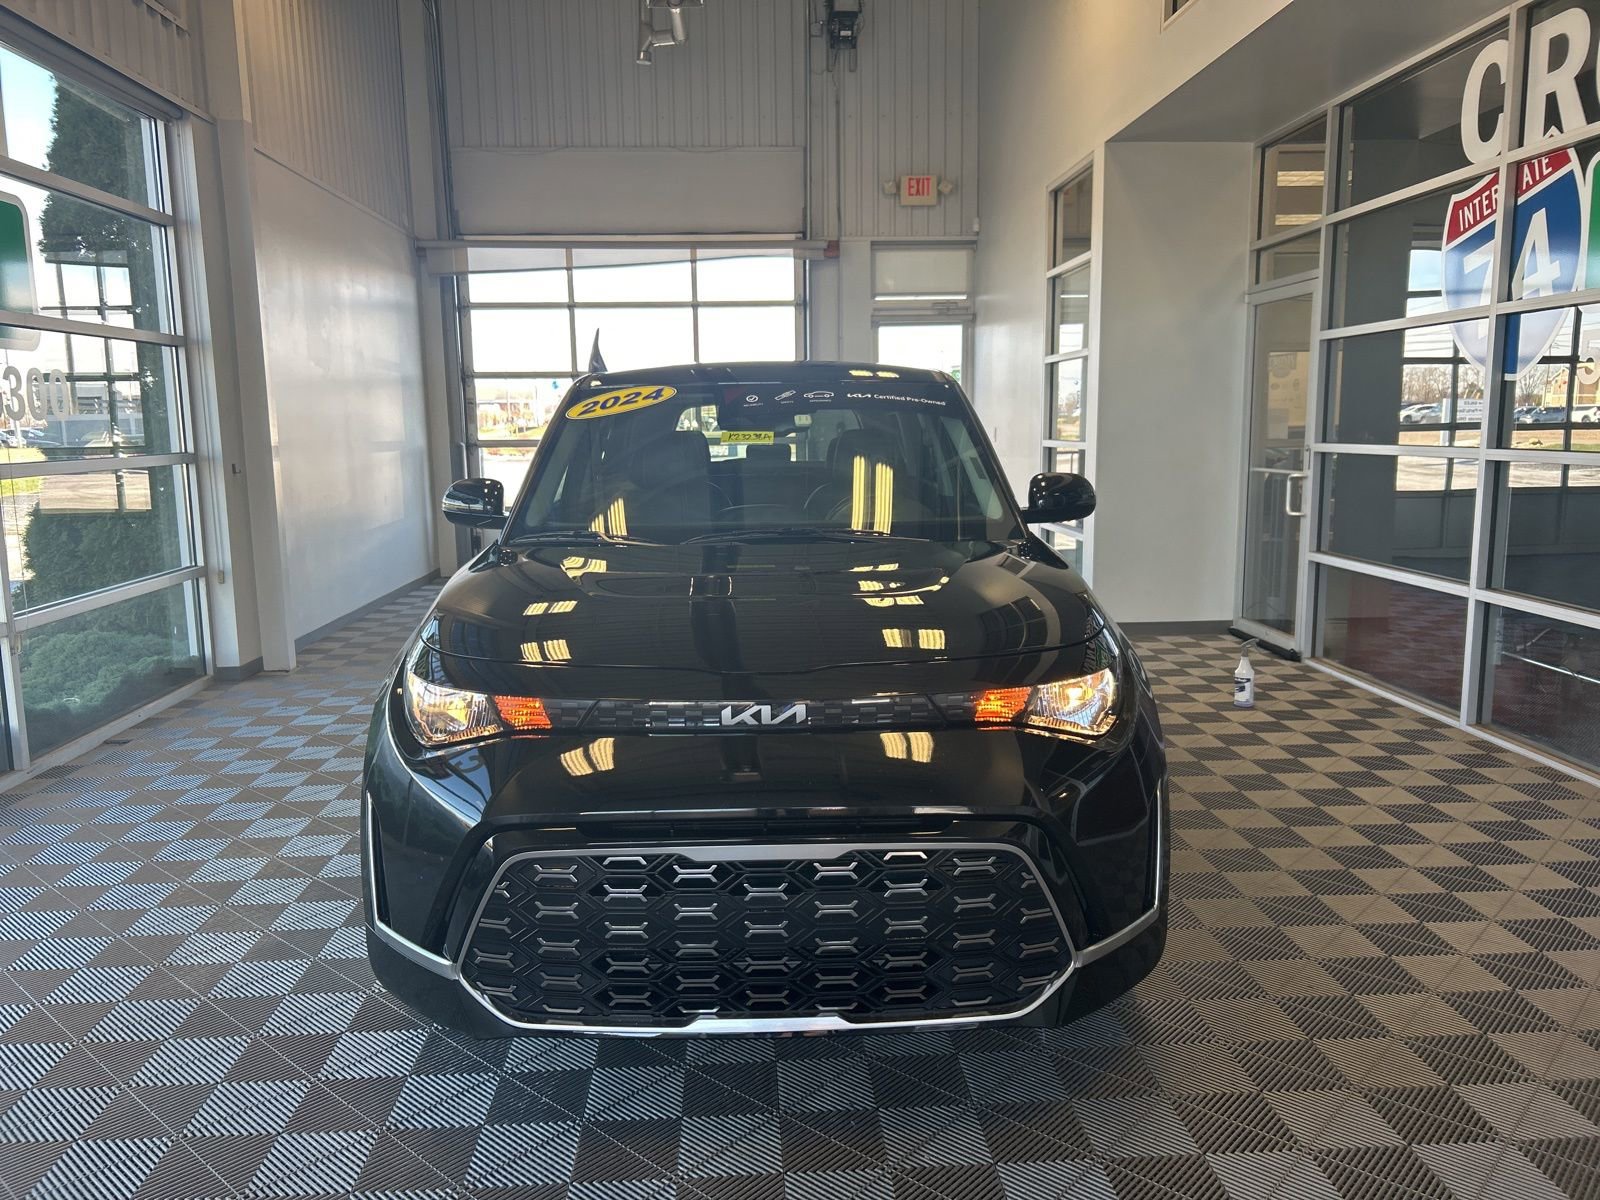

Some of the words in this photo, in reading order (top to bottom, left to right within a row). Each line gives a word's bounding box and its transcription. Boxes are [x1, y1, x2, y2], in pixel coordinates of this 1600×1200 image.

[1461, 7, 1600, 164] CR
[907, 176, 931, 197] EXIT
[577, 386, 665, 417] 2024
[873, 394, 906, 402] Certified
[906, 396, 946, 407] Pre-Owned
[721, 704, 807, 726] KIA
